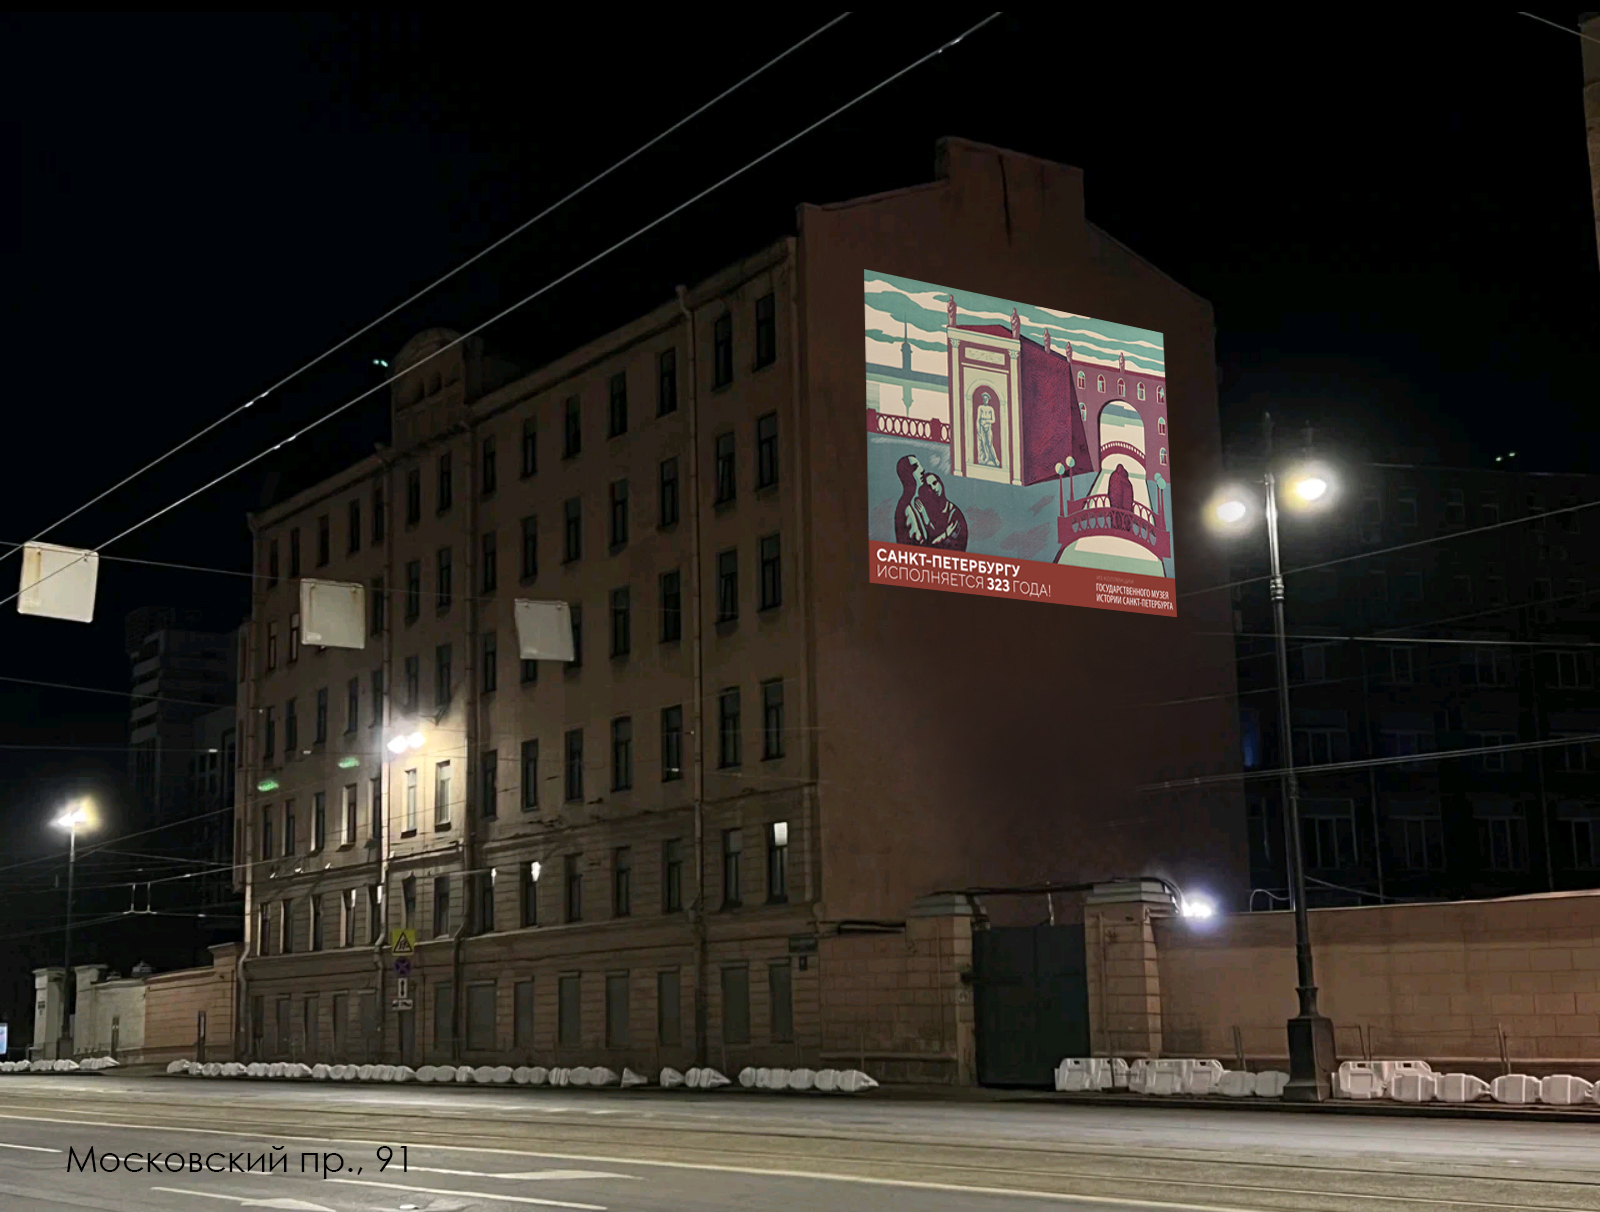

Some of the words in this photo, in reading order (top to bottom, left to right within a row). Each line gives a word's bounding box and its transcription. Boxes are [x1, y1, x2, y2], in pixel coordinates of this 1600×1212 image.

[876, 548, 1020, 577] САНКТ-ПЕТЕРБУРГУ
[876, 564, 984, 589] ИСПОЛНЯЕТСЯ
[986, 577, 1010, 592] 323
[1012, 580, 1051, 598] ГОДА!
[1095, 582, 1150, 598] ГОСУДАРСТВЕННОГО
[1151, 589, 1169, 600] МУЗЕЯ
[1095, 593, 1122, 605] ИСТОРИИ
[1122, 596, 1174, 611] САНКТ-ПЕТЕРБУРГА
